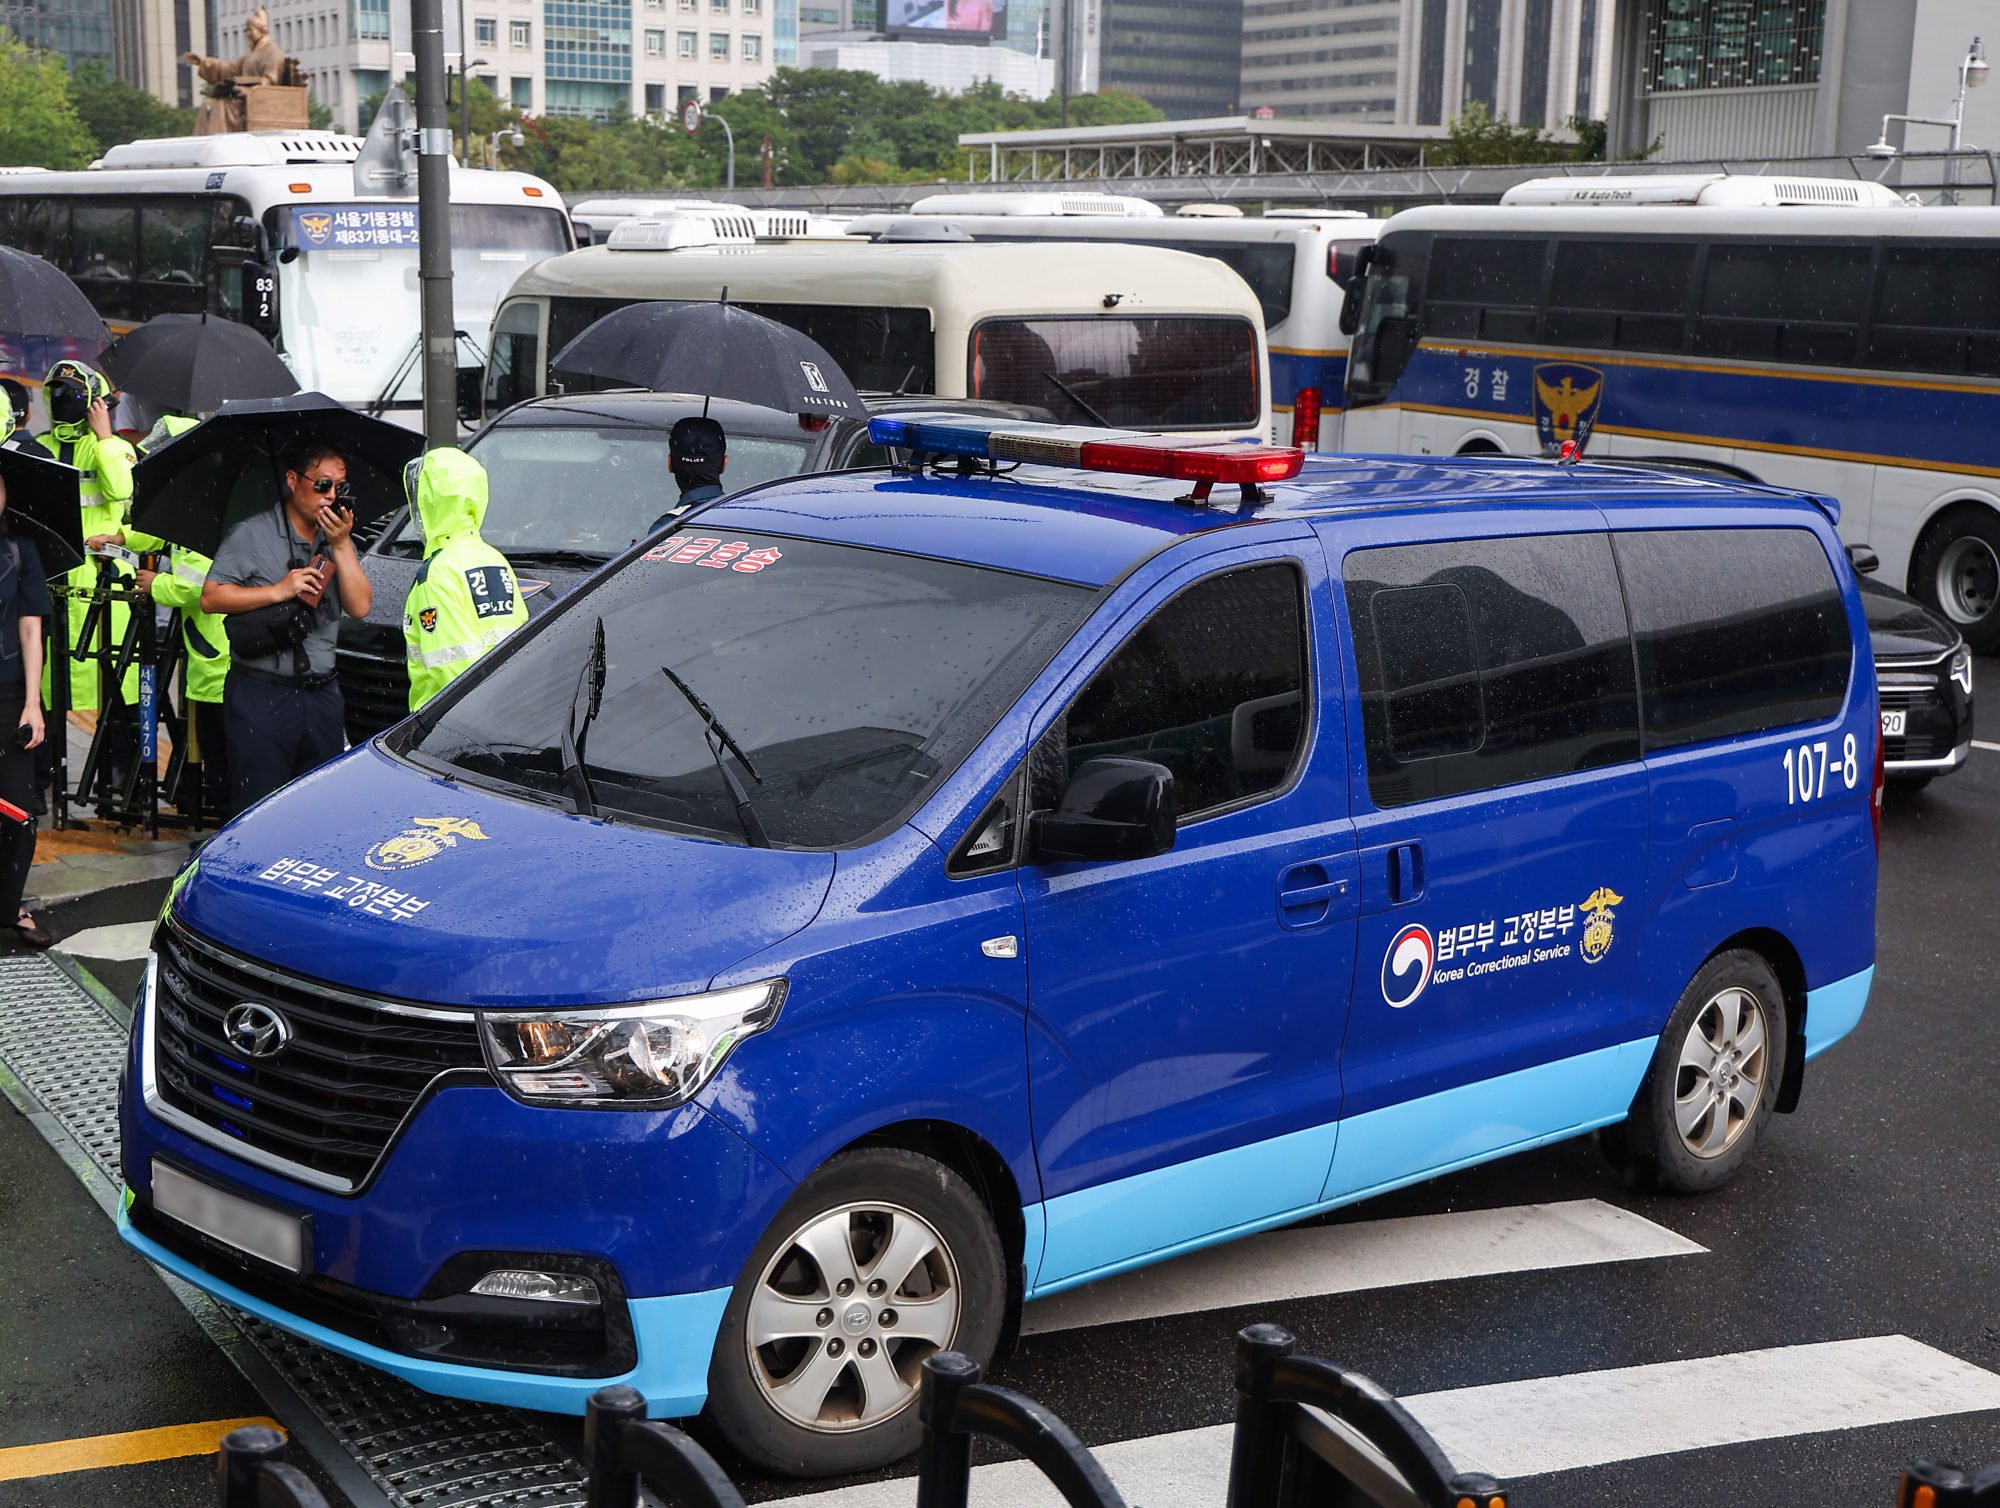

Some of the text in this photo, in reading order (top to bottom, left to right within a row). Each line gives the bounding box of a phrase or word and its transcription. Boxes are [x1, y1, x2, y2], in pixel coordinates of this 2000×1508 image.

[334, 211, 415, 228] 서울기동경찰
[1783, 733, 1858, 805] 107-8
[258, 857, 431, 922] 법무부 교정본부
[1437, 904, 1575, 962] 법무부 교정본부
[1432, 968, 1464, 985] Korea
[1467, 949, 1531, 977] Correctional
[1533, 943, 1571, 963] Service
